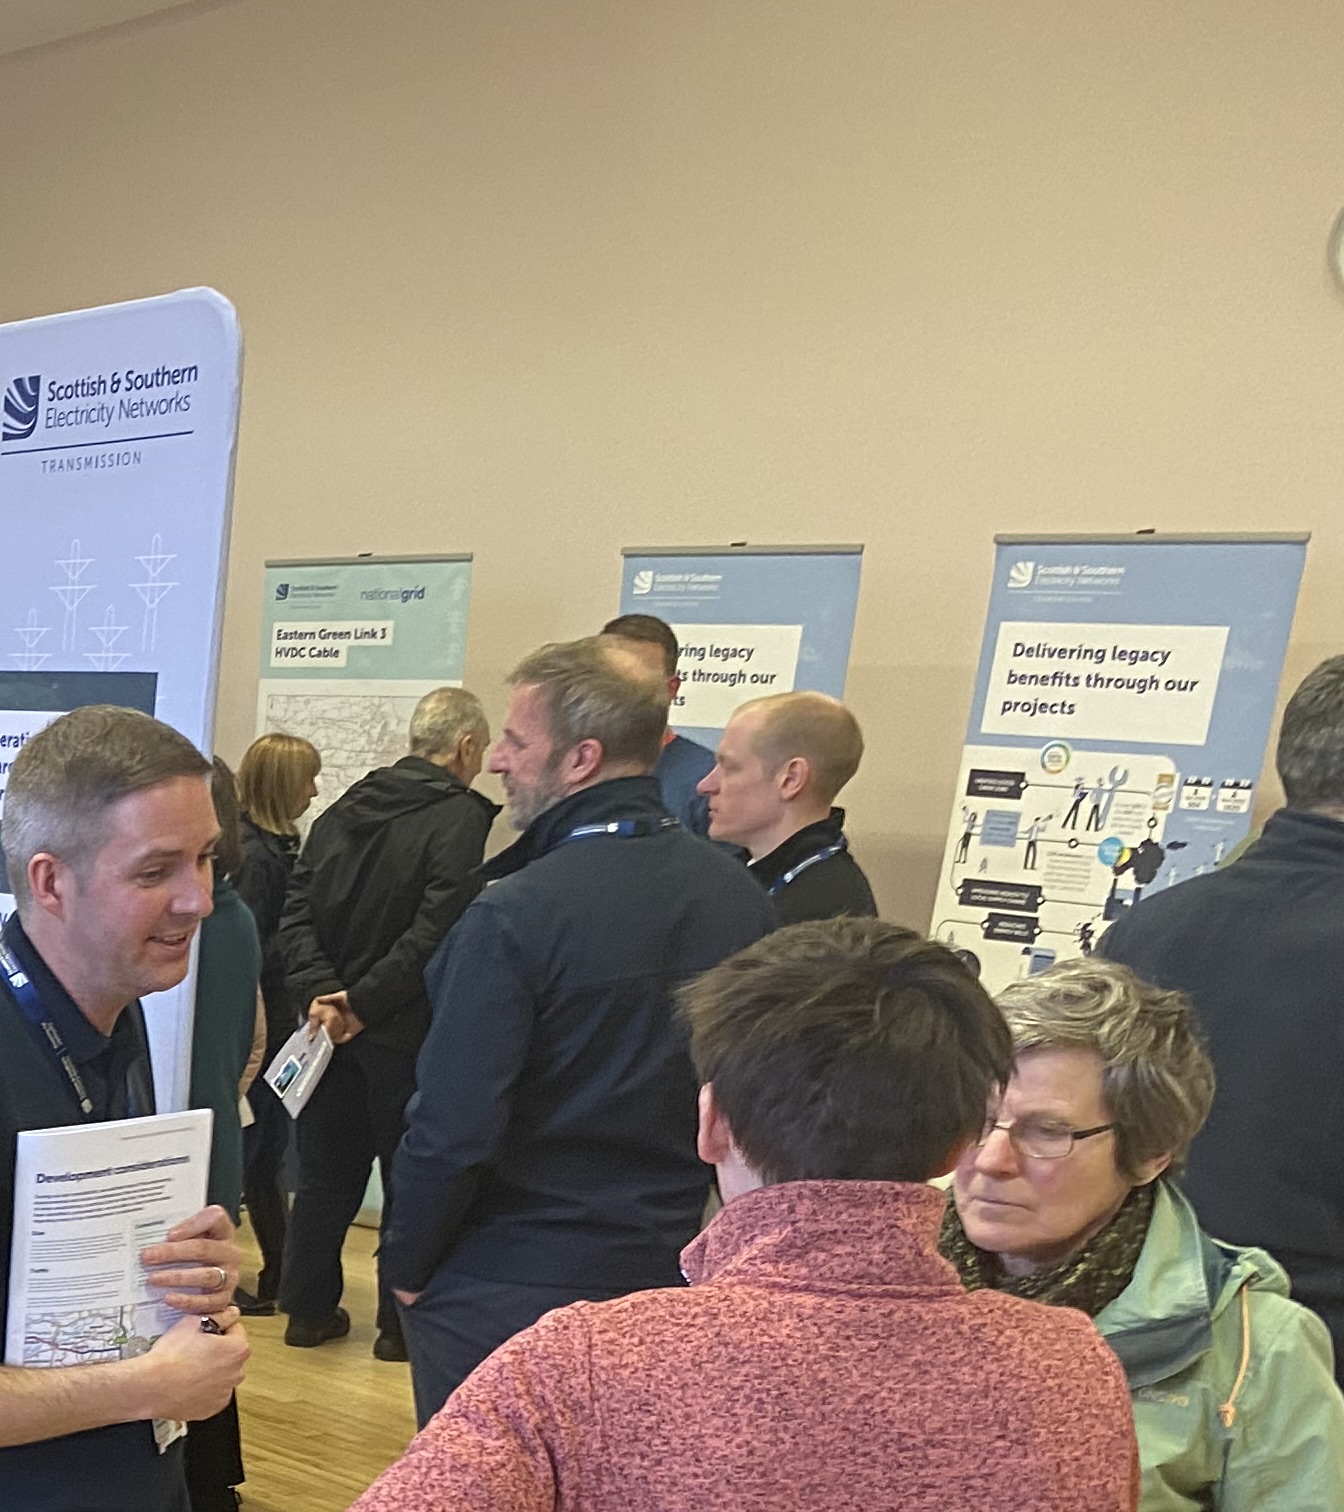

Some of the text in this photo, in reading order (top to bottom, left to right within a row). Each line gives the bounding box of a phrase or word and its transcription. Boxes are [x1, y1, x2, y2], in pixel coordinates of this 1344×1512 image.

[48, 364, 199, 402] Scottish & Southern
[45, 391, 191, 429] Electricity Networks
[41, 451, 142, 473] TRANSMISSION
[276, 627, 388, 641] Eastern Green Link 3
[274, 646, 340, 659] HVDC Cable
[709, 644, 755, 662] legacy
[1012, 642, 1172, 667] Delivering legacy
[691, 669, 746, 687] through
[750, 673, 776, 685] our
[1006, 670, 1199, 694] benefits through our
[1000, 697, 1077, 717] projects
